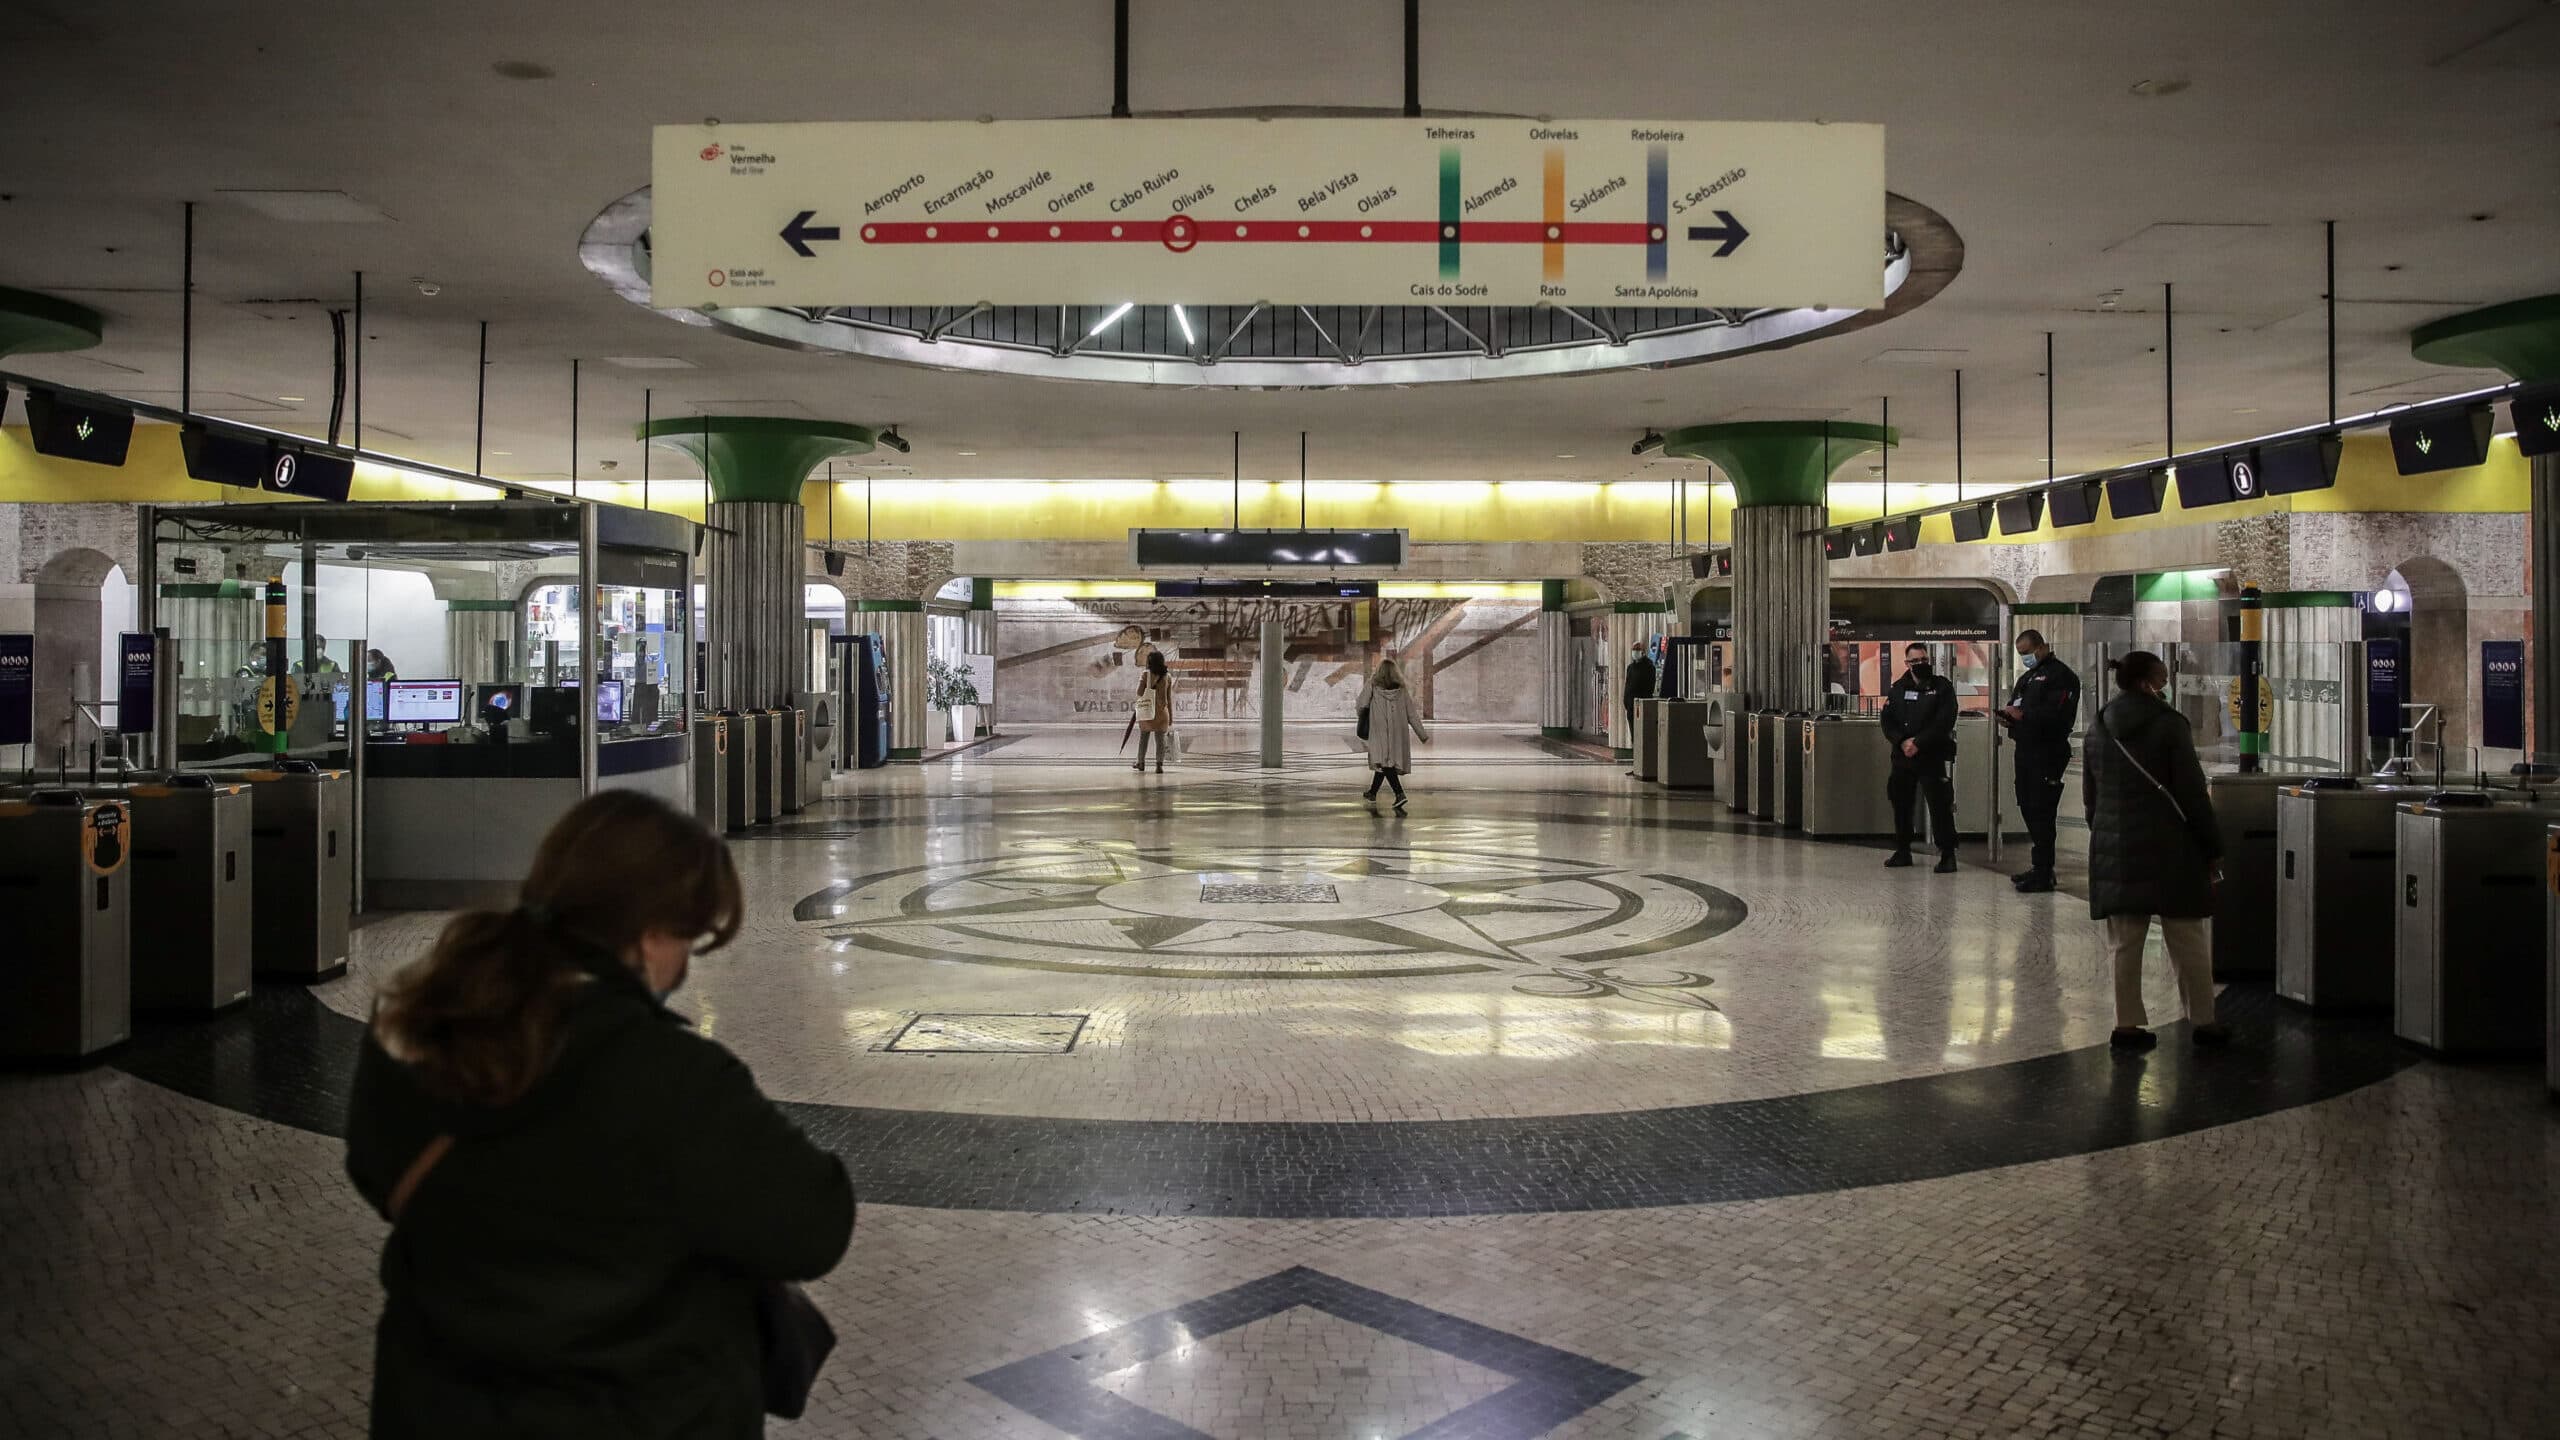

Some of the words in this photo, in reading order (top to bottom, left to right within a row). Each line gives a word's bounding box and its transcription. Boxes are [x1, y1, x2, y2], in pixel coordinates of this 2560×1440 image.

[1425, 127, 1475, 140] Telheiras
[1529, 128, 1579, 140] Odivelas
[1631, 129, 1685, 142] Reboleira
[730, 153, 776, 164] Vermelha
[864, 174, 926, 216] Aeroporto
[923, 169, 995, 215] Encarnação
[985, 170, 1052, 214] Moscavide
[1047, 181, 1096, 213] Oriente
[1109, 189, 1143, 213] Cabo
[1142, 168, 1179, 194] Ruivo
[1172, 183, 1215, 213] Olivais
[1234, 183, 1277, 213] Chelas
[1298, 189, 1327, 212] Bela
[1324, 172, 1359, 195] Vista
[1357, 185, 1397, 213] Olaias
[1464, 176, 1518, 214] Alameda
[1569, 176, 1627, 213] Saldanha
[1672, 200, 1687, 214] S.
[1686, 167, 1747, 207] Sebastião
[1410, 284, 1434, 297] Cais
[1437, 284, 1453, 297] do
[1455, 284, 1488, 297] Sodré
[1540, 285, 1566, 297] Rato
[1615, 285, 1647, 297] Santa
[1647, 286, 1699, 299] Apolónia
[1073, 701, 1113, 713] VALE
